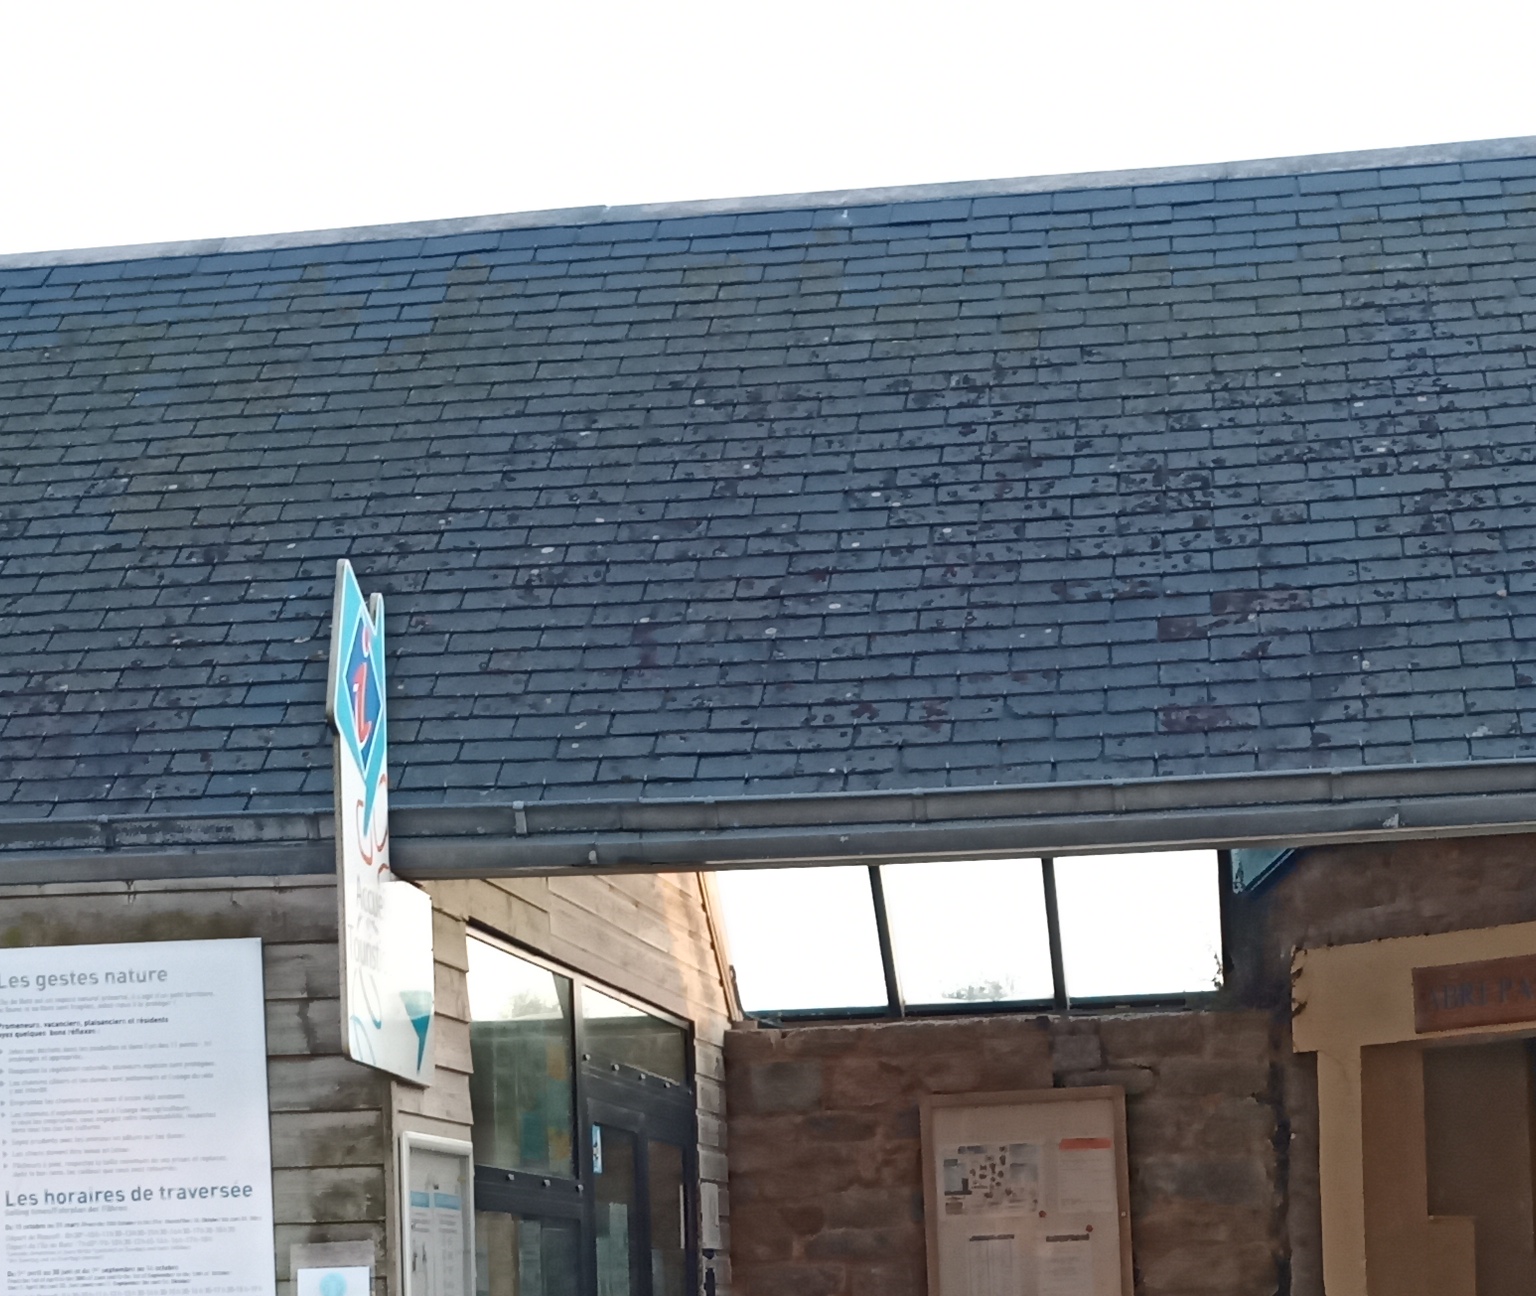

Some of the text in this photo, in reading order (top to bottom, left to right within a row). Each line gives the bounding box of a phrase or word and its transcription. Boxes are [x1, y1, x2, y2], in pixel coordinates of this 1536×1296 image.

[35, 970, 99, 991] gestes
[104, 968, 169, 984] nature
[5, 1179, 254, 1208] Les horaires de traversée
